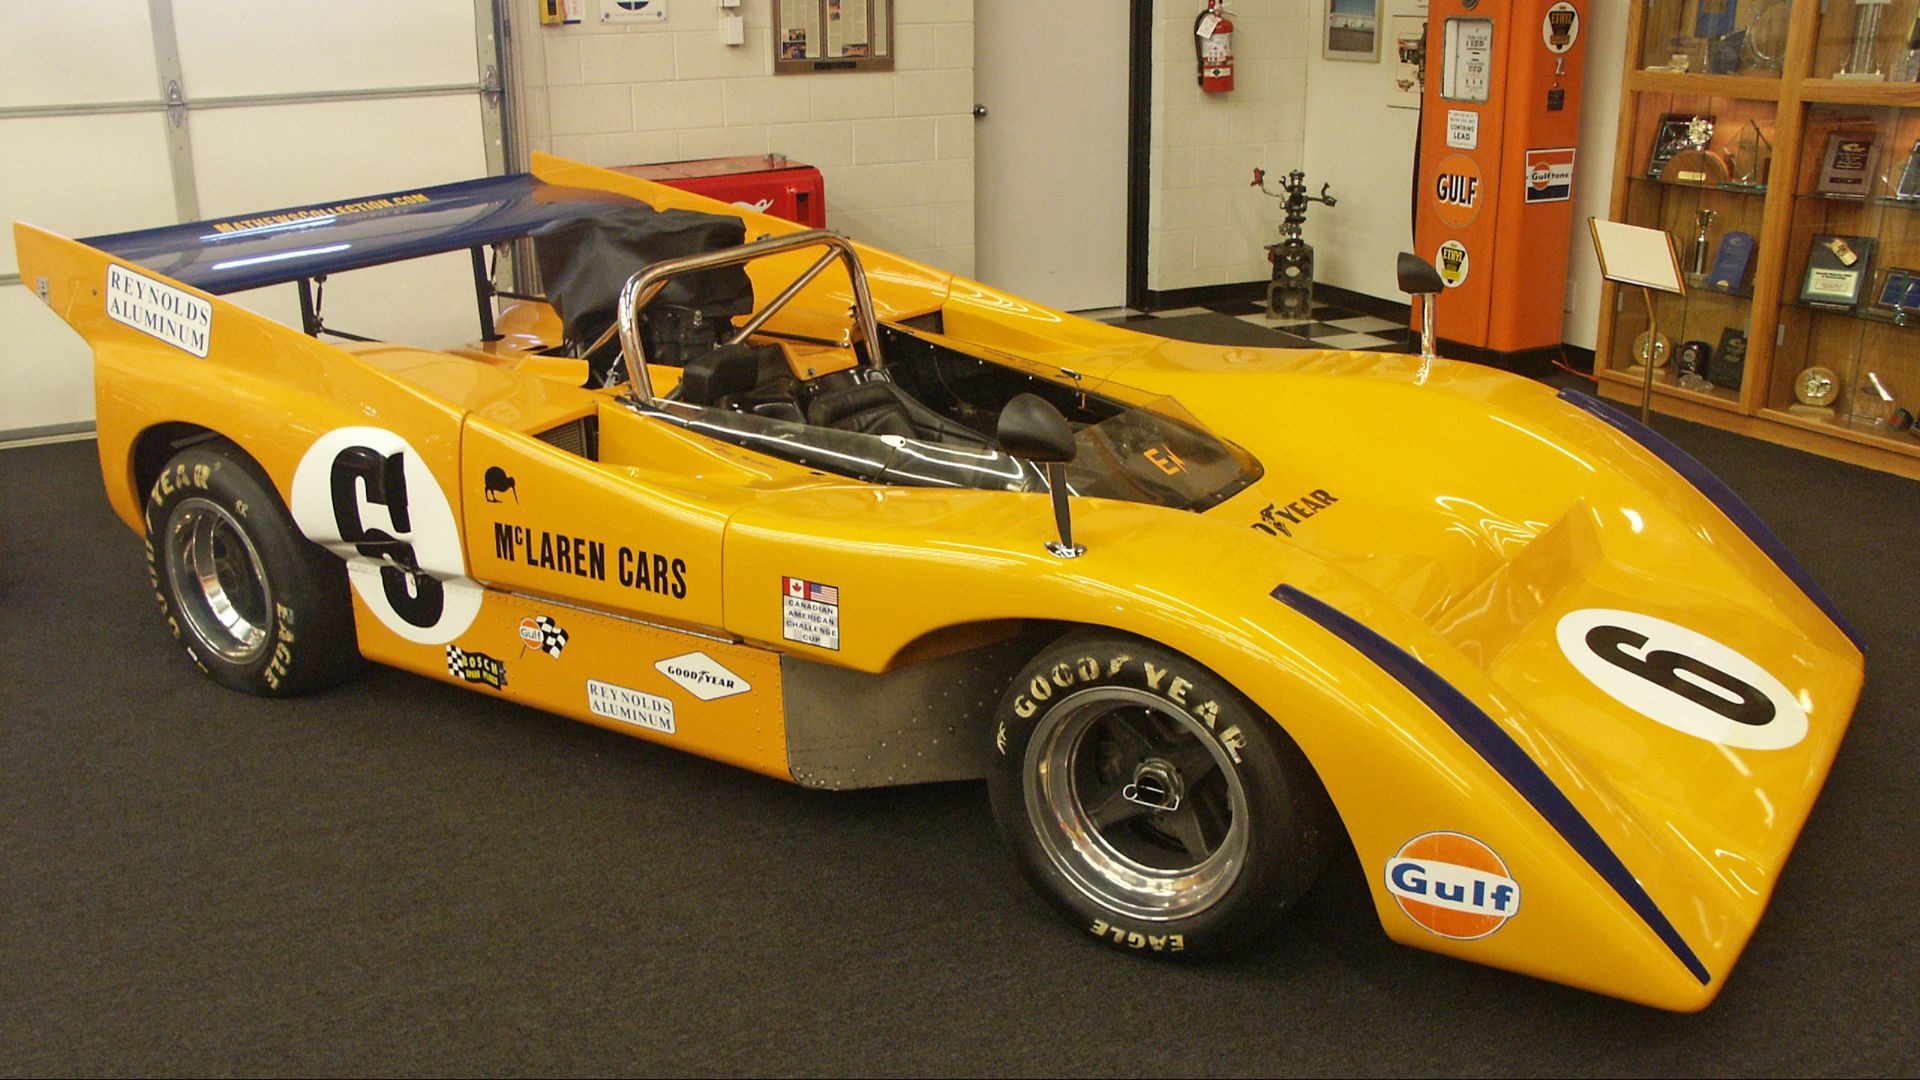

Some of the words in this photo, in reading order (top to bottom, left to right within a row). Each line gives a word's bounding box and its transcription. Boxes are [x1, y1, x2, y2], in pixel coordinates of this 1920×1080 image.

[1453, 131, 1470, 141] LEAD
[1437, 173, 1478, 208] GULF
[1443, 249, 1464, 262] ETHYL
[111, 271, 208, 326] REYNOLDS
[110, 297, 204, 351] ALUMINUM
[331, 445, 444, 629] 6
[618, 546, 686, 600] CARS
[788, 599, 833, 615] CANADIAN
[788, 610, 835, 626] AMERICAN
[520, 627, 542, 640] Gulf
[786, 620, 836, 637] CHALLENGE
[802, 634, 821, 643] CUP
[264, 602, 294, 691] EAGLE
[461, 655, 499, 675] BOSCH
[1585, 624, 1776, 727] 6
[589, 683, 671, 715] REYNOLDS
[592, 700, 671, 731] ALUMINUM
[1391, 862, 1514, 912] Gulf
[1090, 919, 1184, 952] EAGLE
